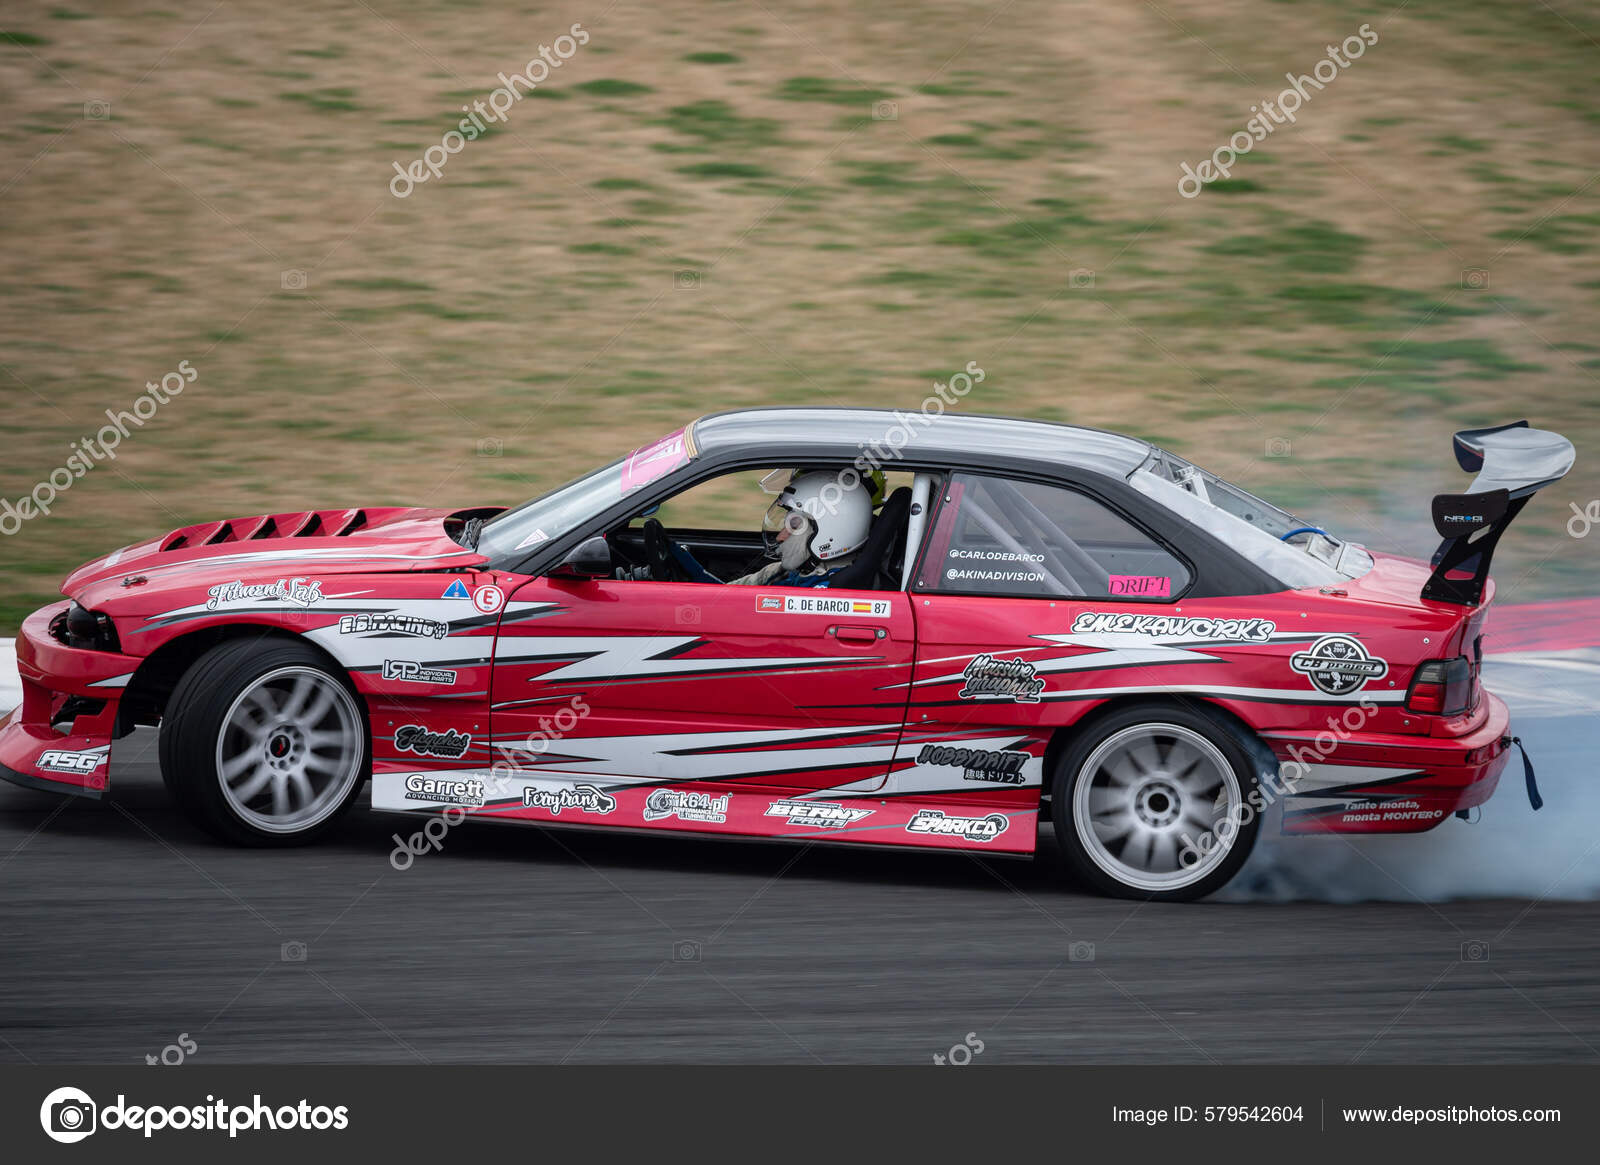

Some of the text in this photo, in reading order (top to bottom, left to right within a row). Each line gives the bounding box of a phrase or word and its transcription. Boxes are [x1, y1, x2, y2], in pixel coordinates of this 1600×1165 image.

[949, 549, 1045, 563] @CARLODEBARCO
[946, 569, 1045, 582] @AKINADIVISION
[280, 577, 327, 608] Lab
[1110, 576, 1166, 595] DRIFT
[483, 589, 494, 605] E
[787, 598, 797, 610] C.
[801, 599, 813, 611] DE
[816, 600, 850, 613] BARCO
[874, 602, 887, 614] 87
[963, 654, 1036, 680] Massive
[1300, 658, 1377, 671] CB project
[406, 673, 453, 683] RACING PARTS
[419, 670, 454, 678] INDIVIDUAL
[38, 752, 99, 769] ASG
[918, 745, 1029, 772] HOBBYDRIFT
[405, 774, 484, 798] Garrett
[406, 793, 450, 802] ADVANCING
[767, 804, 872, 820] BERNY
[1344, 801, 1420, 810] Tanto monta,
[791, 816, 846, 827] PARTS
[1343, 810, 1443, 822] monta MONTERO
